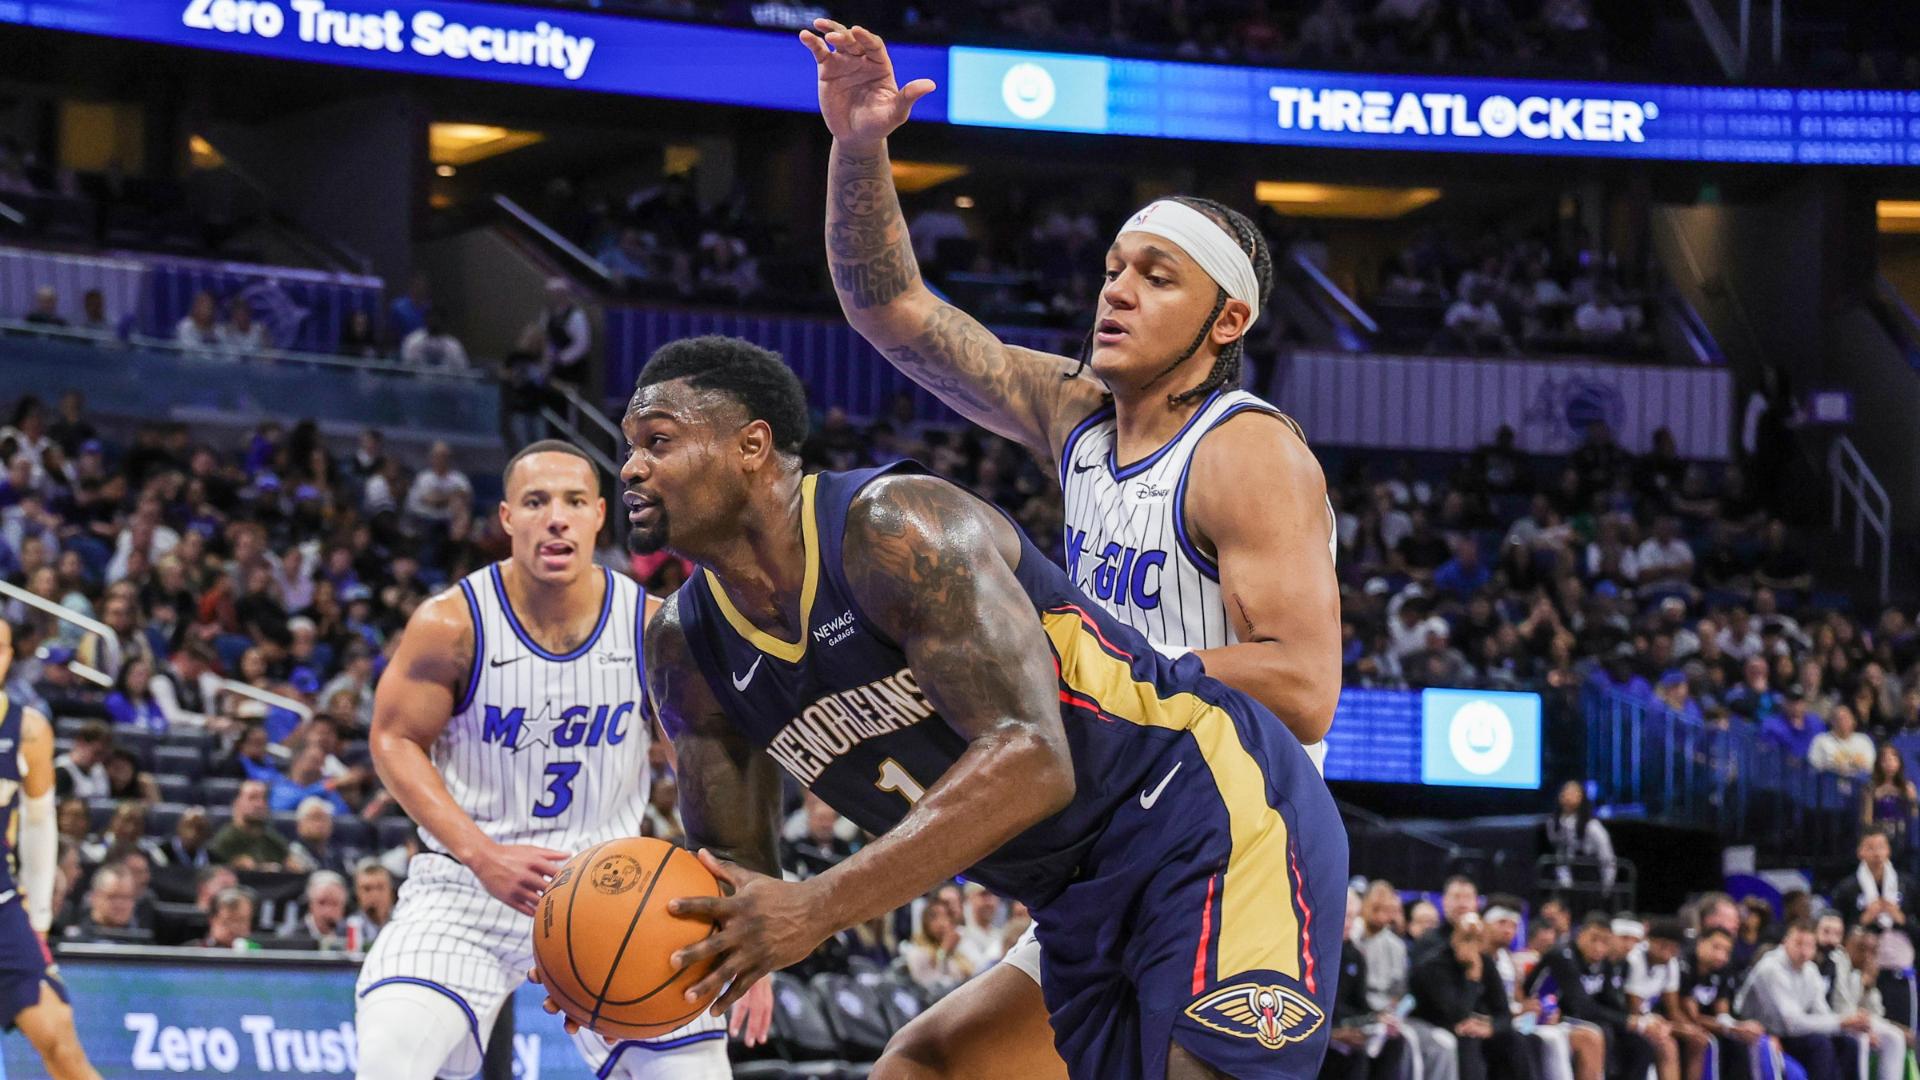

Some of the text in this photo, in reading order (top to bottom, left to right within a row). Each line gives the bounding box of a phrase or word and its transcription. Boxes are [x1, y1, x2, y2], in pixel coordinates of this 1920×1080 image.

[182, 0, 596, 81] Zero Trust Security
[1269, 86, 1646, 143] THREATLOCKER
[1136, 482, 1170, 500] Disney
[828, 626, 855, 646] GARAGE
[531, 761, 582, 819] 3
[874, 757, 927, 805] 1
[124, 1012, 358, 1073] Zero Trust
